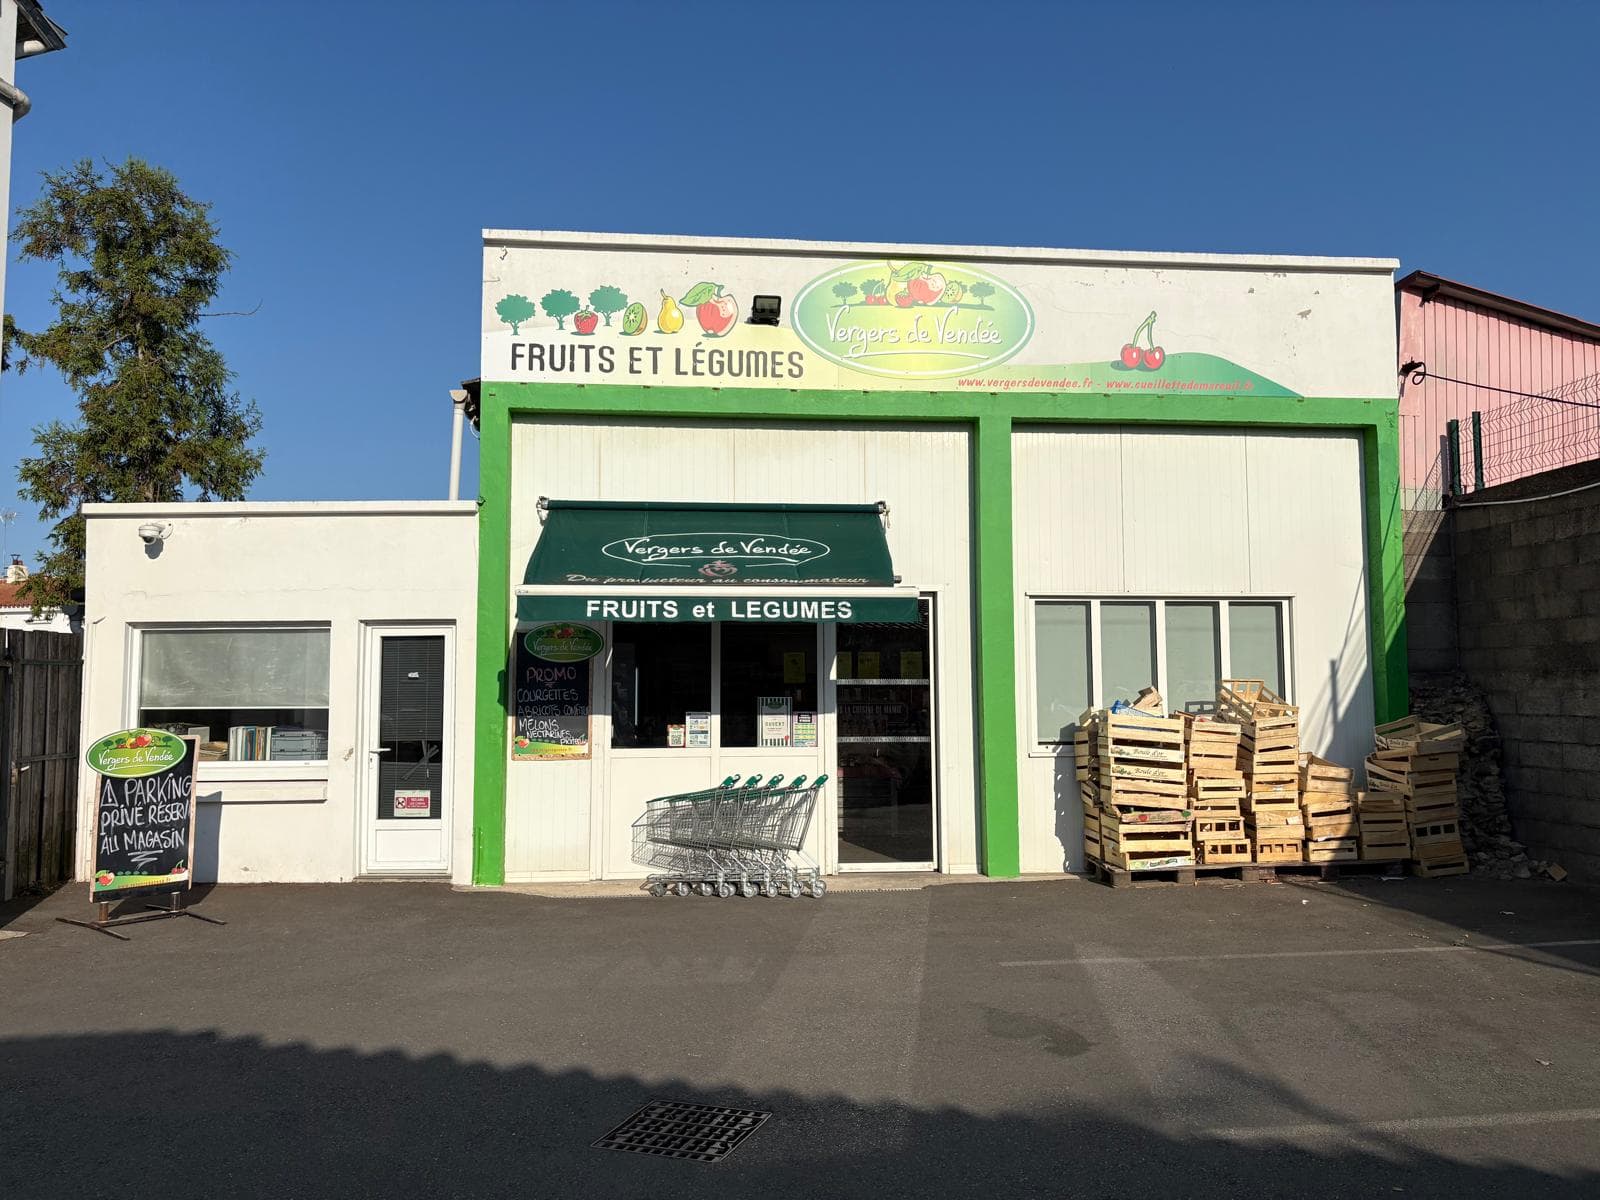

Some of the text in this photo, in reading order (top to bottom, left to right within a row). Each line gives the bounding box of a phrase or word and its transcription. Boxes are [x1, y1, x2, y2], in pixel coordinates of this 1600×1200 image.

[826, 305, 1002, 357] Vergers de Vendée
[511, 341, 804, 378] FRUITS ET LÉGUMES
[958, 377, 1093, 390] www.vergersdevendee.fr
[624, 538, 812, 561] Vergers de Vendée
[586, 600, 853, 620] FRUITS et LEGUMES
[526, 666, 576, 683] PROMO
[517, 688, 579, 702] COURGETTES
[98, 746, 175, 771] Vergers de Vendée
[124, 773, 192, 807] PARKING
[101, 799, 191, 833] PRIVÉ RÉSERV
[101, 828, 185, 855] AU MAGASIN
